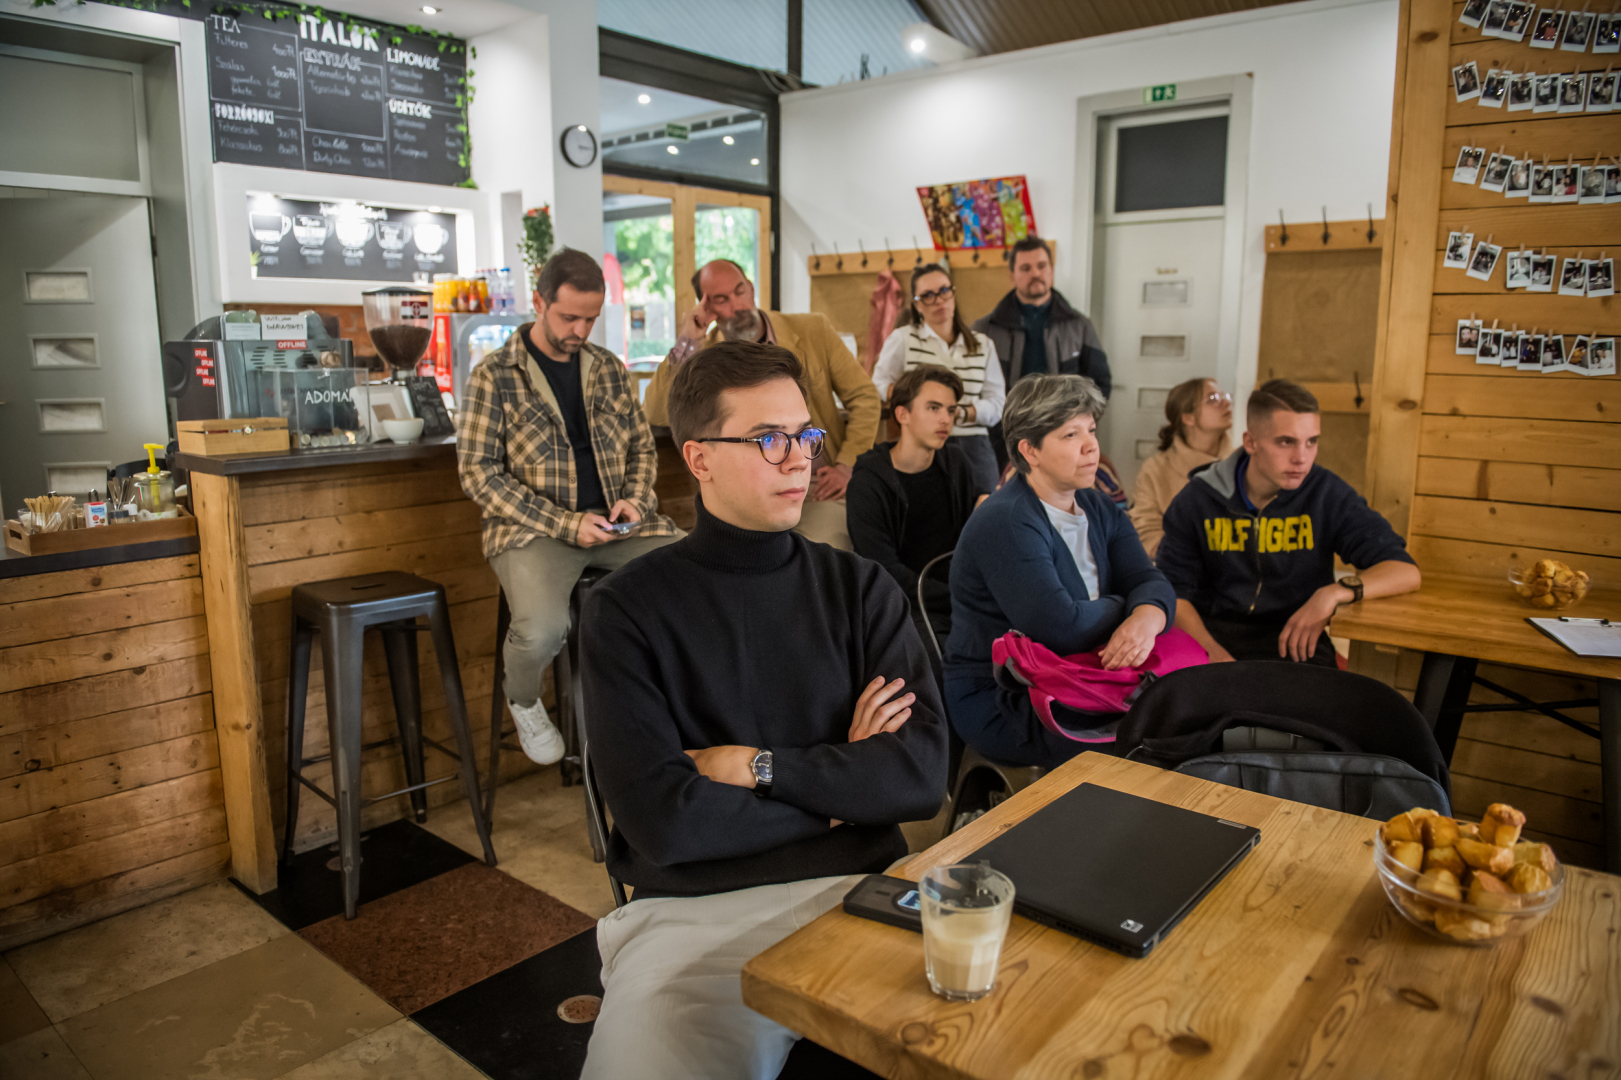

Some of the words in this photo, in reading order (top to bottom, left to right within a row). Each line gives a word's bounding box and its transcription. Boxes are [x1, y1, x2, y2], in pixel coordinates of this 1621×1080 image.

[211, 15, 240, 33] TEA
[300, 14, 379, 51] ITALOK
[304, 48, 361, 71] EXTRÁK
